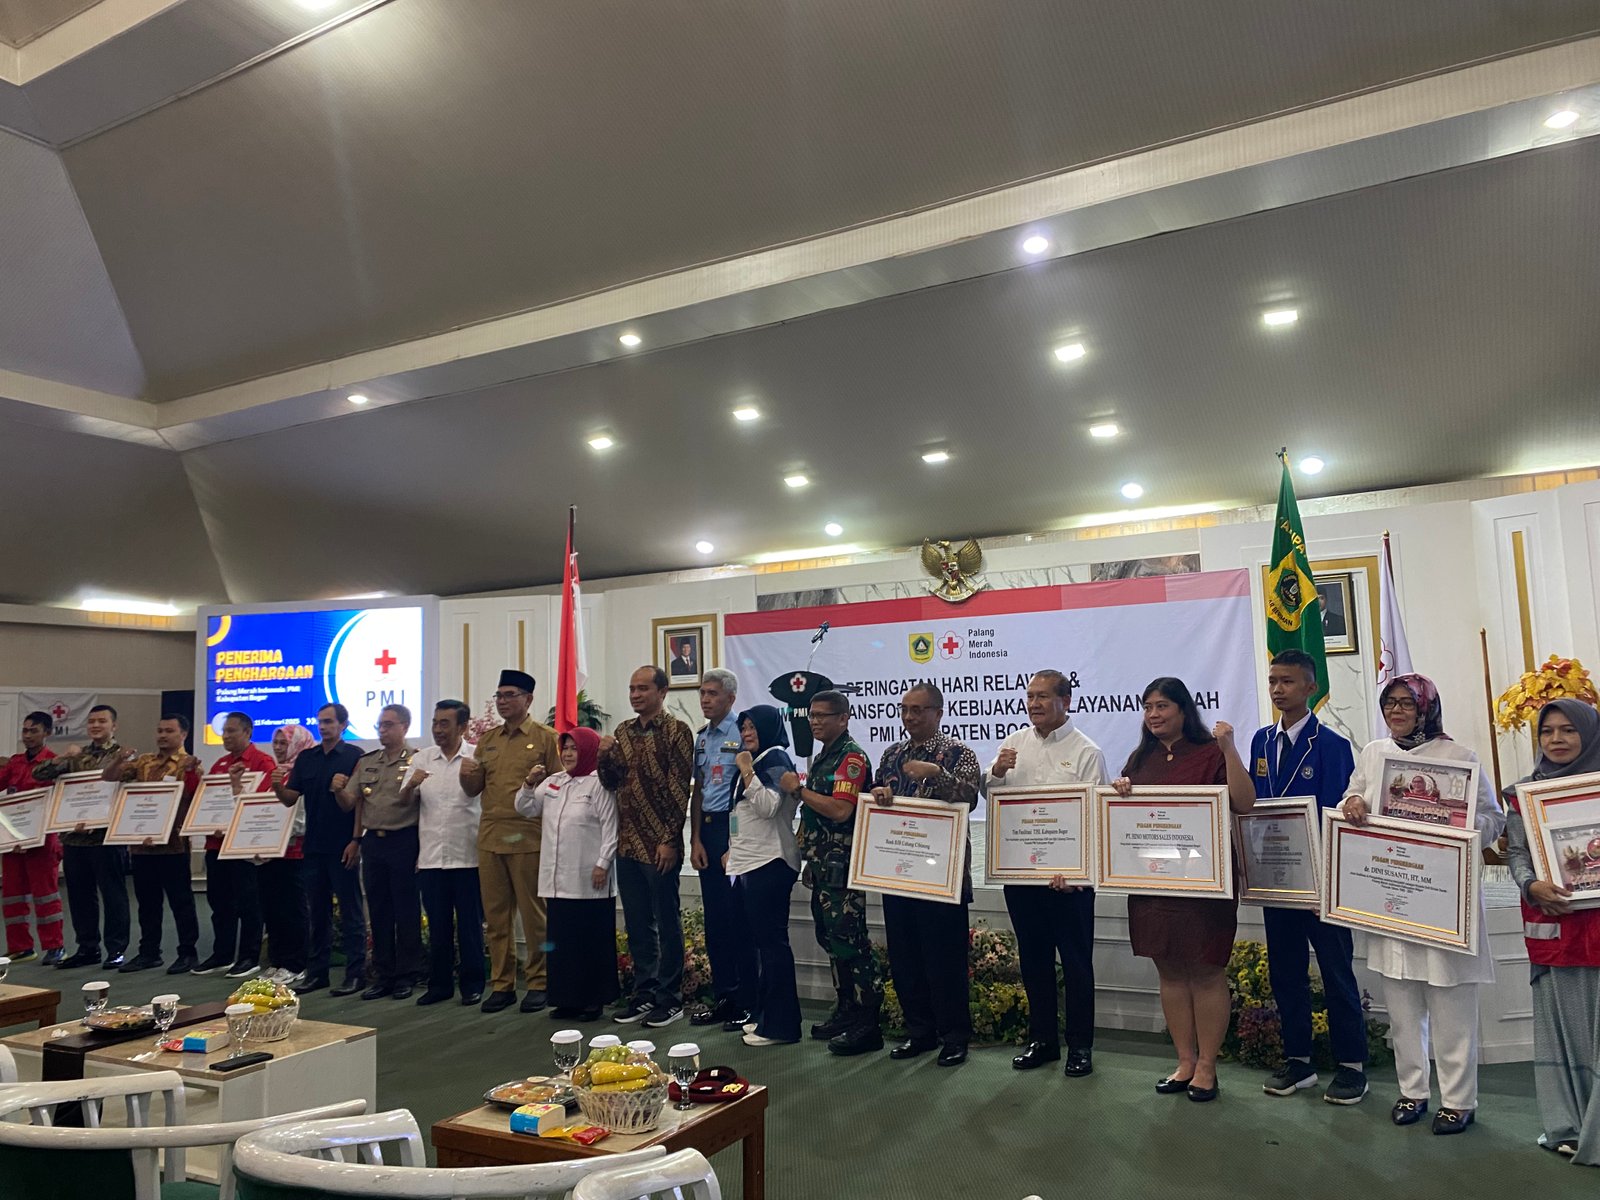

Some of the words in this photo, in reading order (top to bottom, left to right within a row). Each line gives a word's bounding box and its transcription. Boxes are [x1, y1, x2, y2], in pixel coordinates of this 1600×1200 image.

[968, 628, 995, 637] Palang
[968, 639, 992, 648] Merah
[215, 649, 283, 665] PENERIMA
[969, 649, 1008, 659] Indonesia
[215, 665, 314, 683] PENGHARGAAN
[942, 675, 978, 693] HARI
[366, 690, 405, 707] PMI
[793, 707, 807, 717] PMI
[948, 698, 1028, 717] KEBIJAKA
[870, 726, 895, 742] PMI
[899, 723, 991, 742] KPATEN
[1370, 867, 1384, 875] DINI
[1384, 870, 1410, 881] SUSANTI,
[1420, 876, 1432, 884] MM
